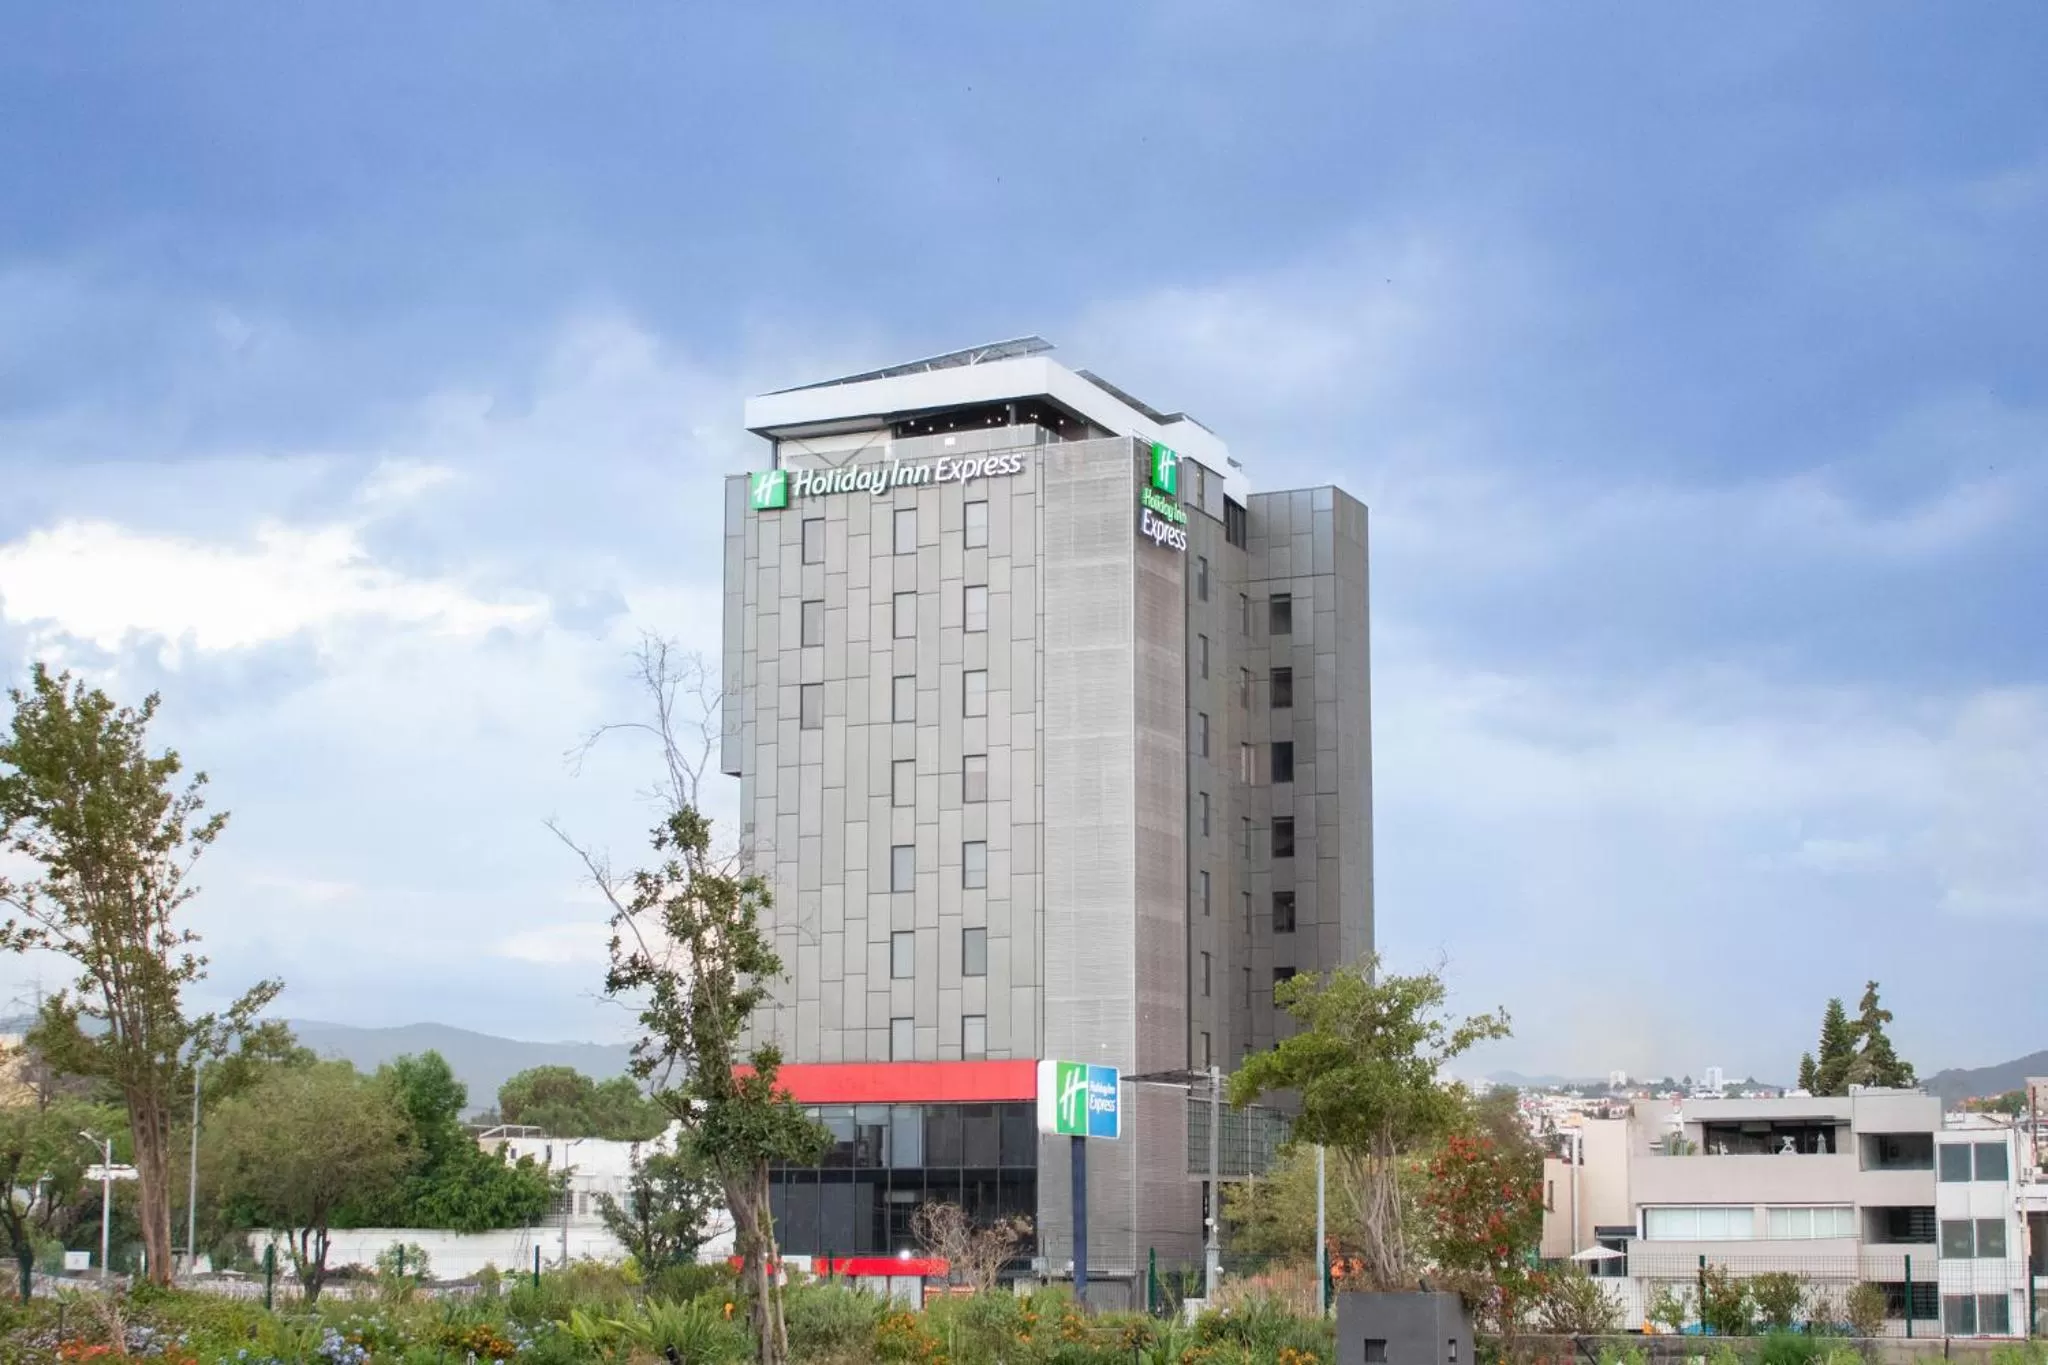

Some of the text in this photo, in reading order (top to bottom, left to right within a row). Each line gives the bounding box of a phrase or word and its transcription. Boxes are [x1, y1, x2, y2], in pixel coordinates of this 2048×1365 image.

[793, 453, 1022, 496] Holiday Inn Express
[1143, 508, 1186, 551] Express
